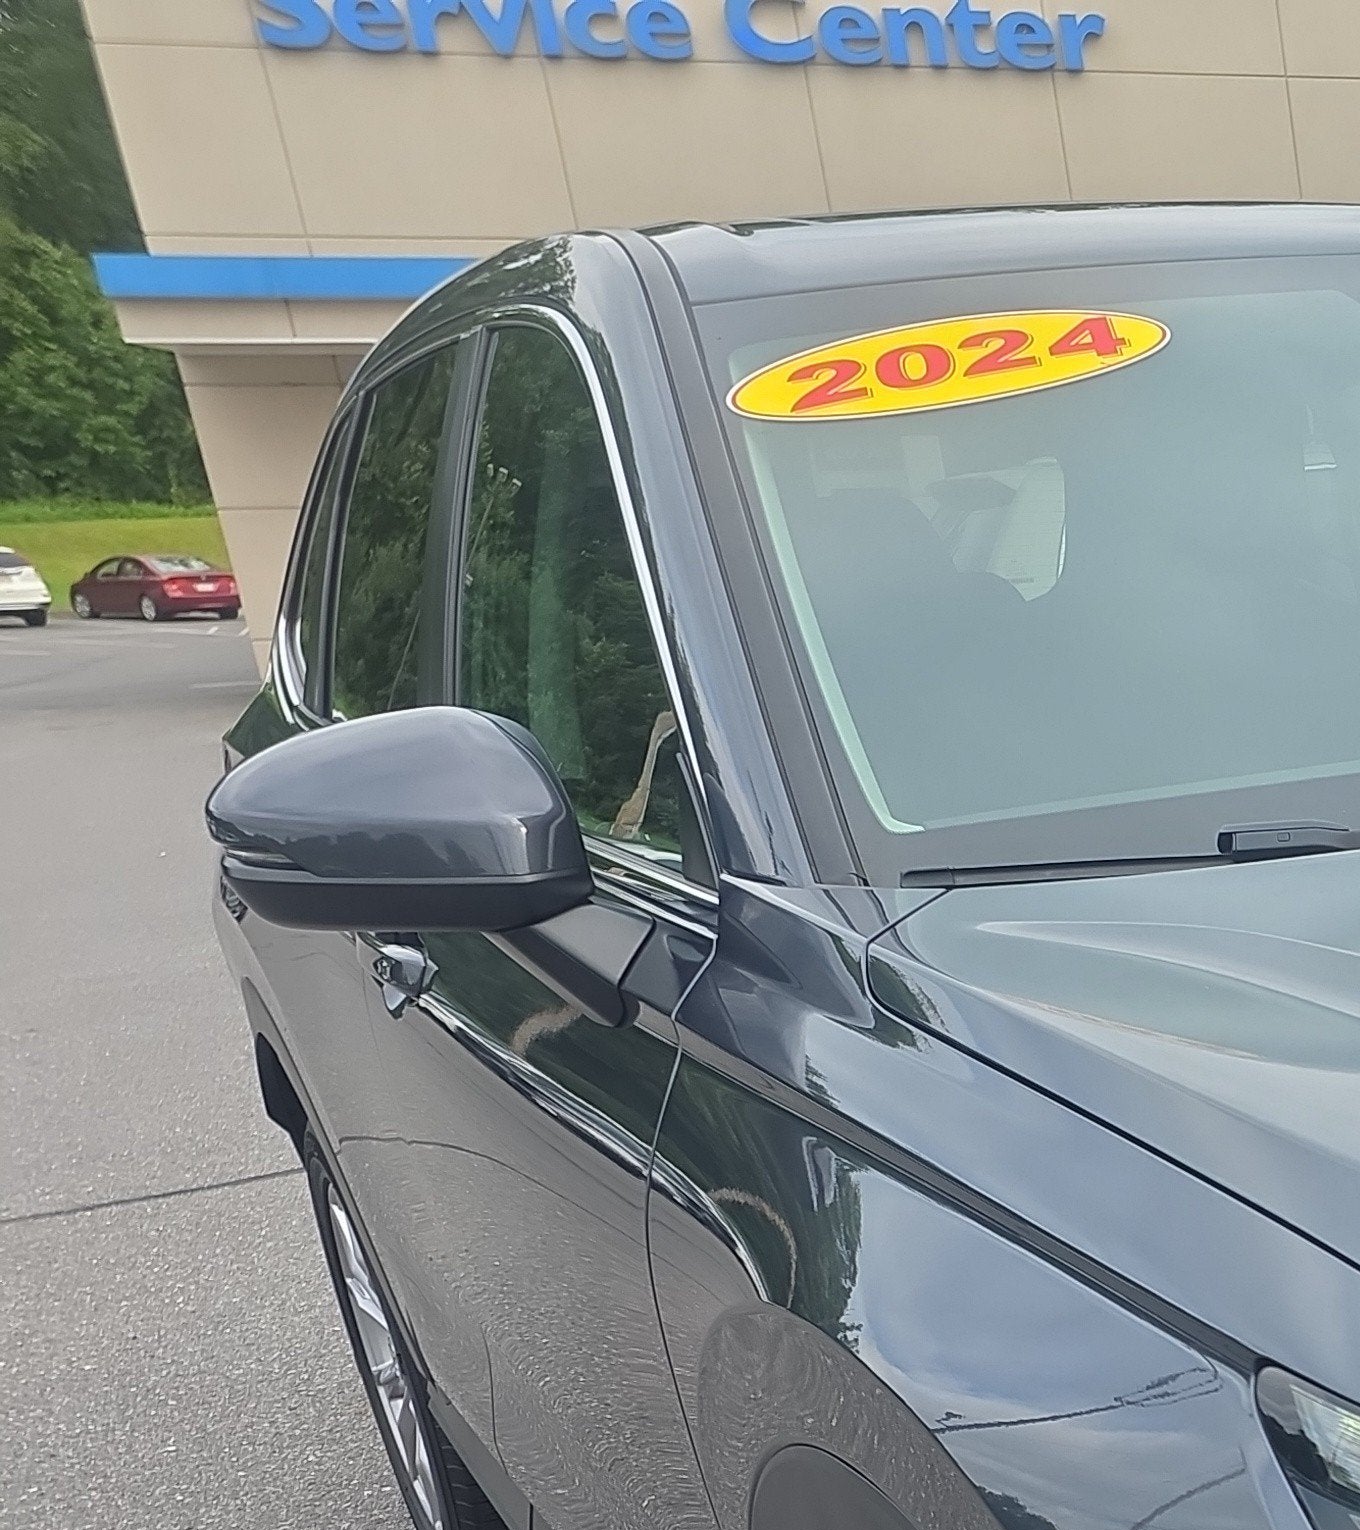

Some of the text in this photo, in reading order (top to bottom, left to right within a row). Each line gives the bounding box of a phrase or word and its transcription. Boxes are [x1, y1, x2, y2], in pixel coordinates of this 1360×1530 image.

[257, 0, 1105, 71] Service Center
[787, 316, 1131, 413] 2024
